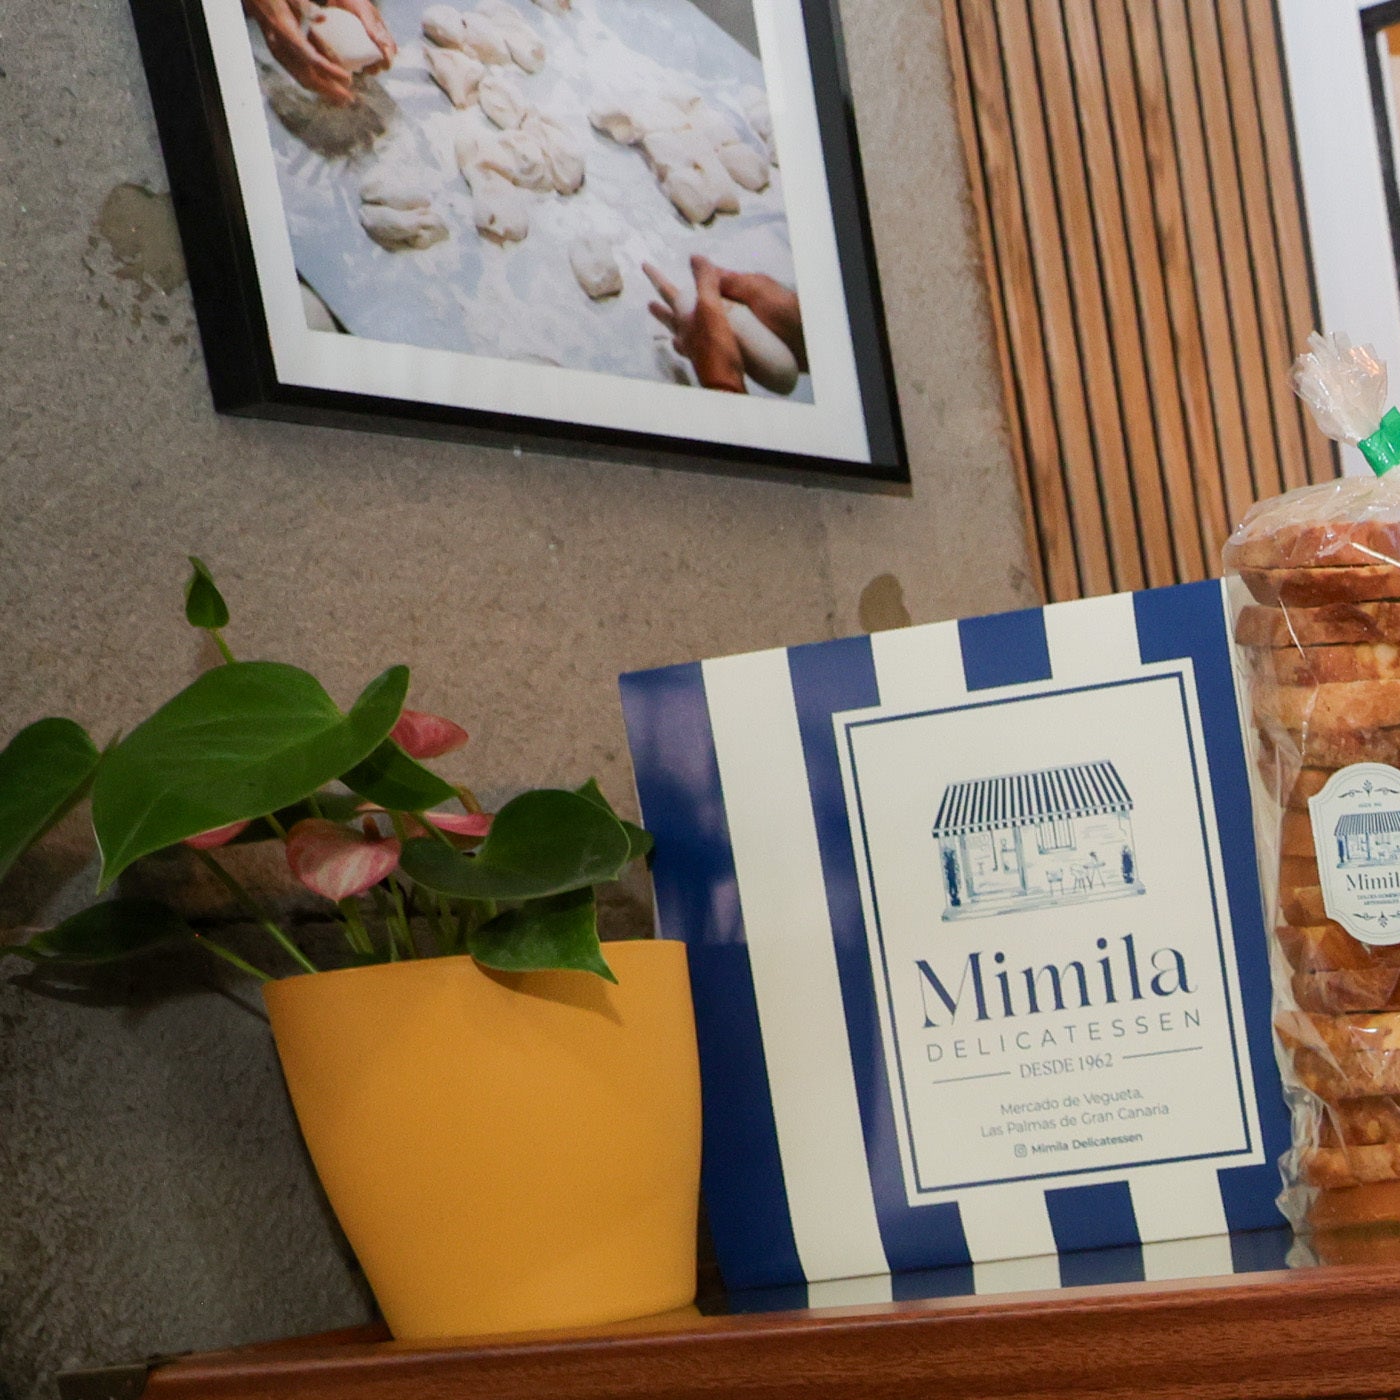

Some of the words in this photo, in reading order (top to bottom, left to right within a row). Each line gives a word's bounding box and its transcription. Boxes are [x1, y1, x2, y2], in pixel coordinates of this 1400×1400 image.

[913, 933, 1199, 1028] Mimila
[926, 1009, 1201, 1062] DELICATESSEN
[1020, 1058, 1074, 1078] DESDE
[1078, 1053, 1114, 1071] 1962
[980, 1124, 1004, 1138] Las
[1007, 1115, 1057, 1135] Palmas
[1060, 1114, 1077, 1127] de
[1081, 1110, 1114, 1126] Gran
[1118, 1103, 1170, 1121] Canaria
[1000, 1096, 1060, 1116] Mercado
[1063, 1096, 1080, 1108] de
[1031, 1140, 1070, 1154] Mimila
[1072, 1132, 1144, 1150] Delicatessen
